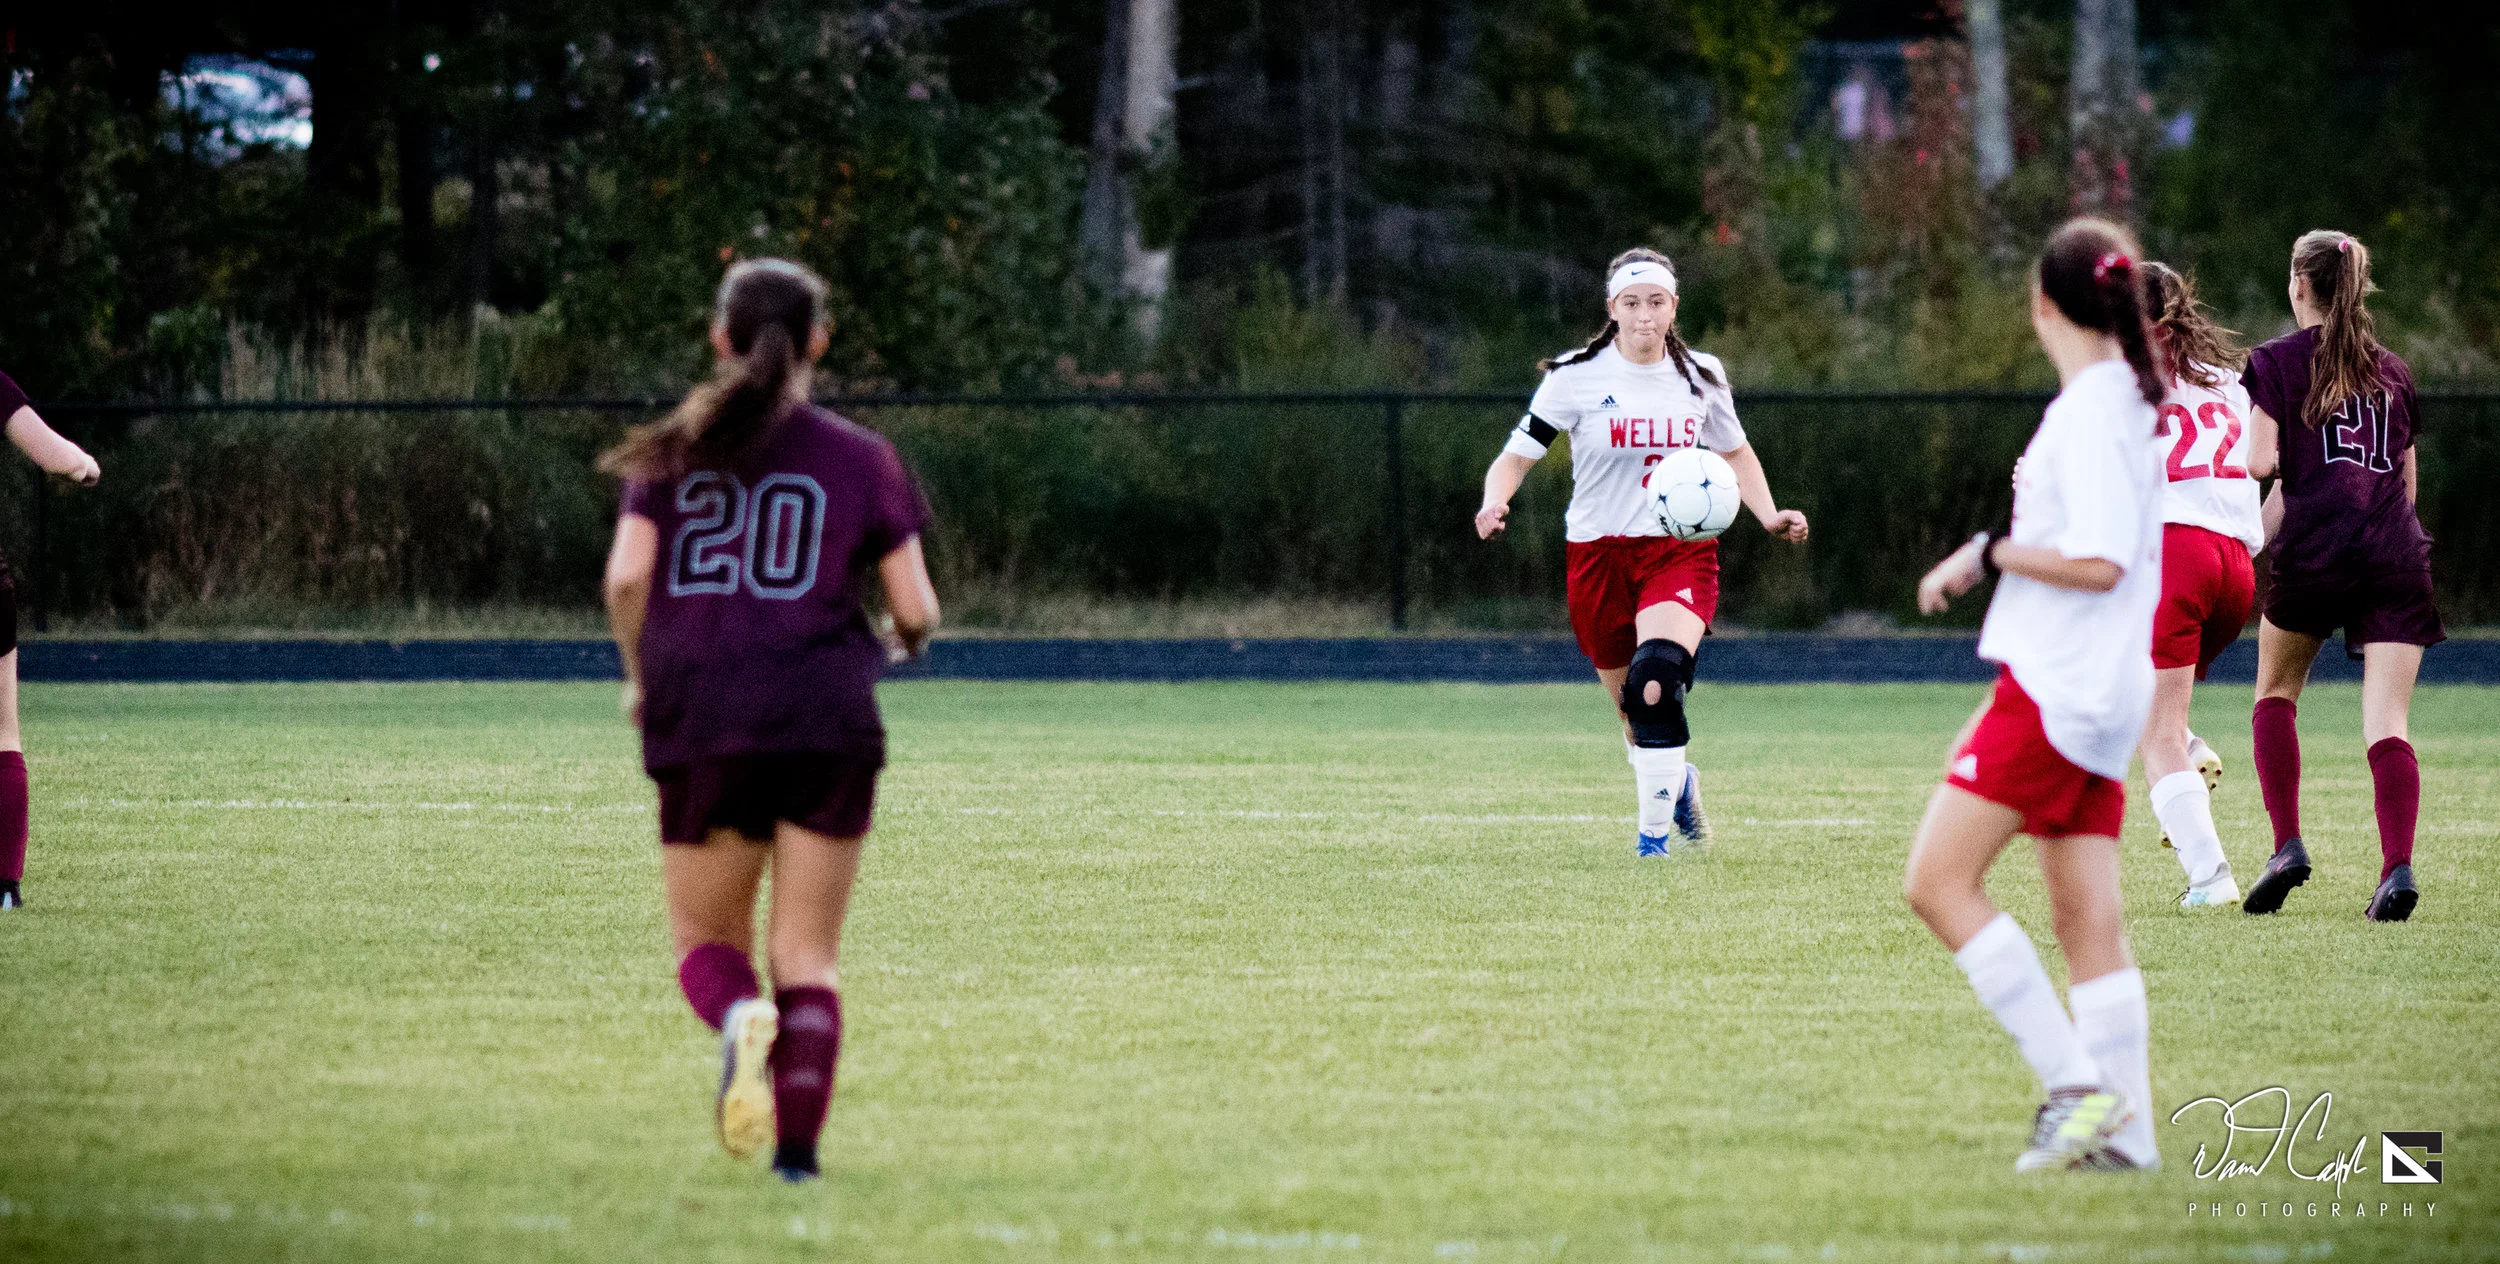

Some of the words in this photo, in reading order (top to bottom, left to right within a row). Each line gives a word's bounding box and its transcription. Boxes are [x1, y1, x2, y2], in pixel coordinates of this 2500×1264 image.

[1608, 417, 1696, 449] WELLS
[2154, 401, 2247, 483] 22
[2323, 393, 2393, 473] 21
[668, 471, 827, 600] 20
